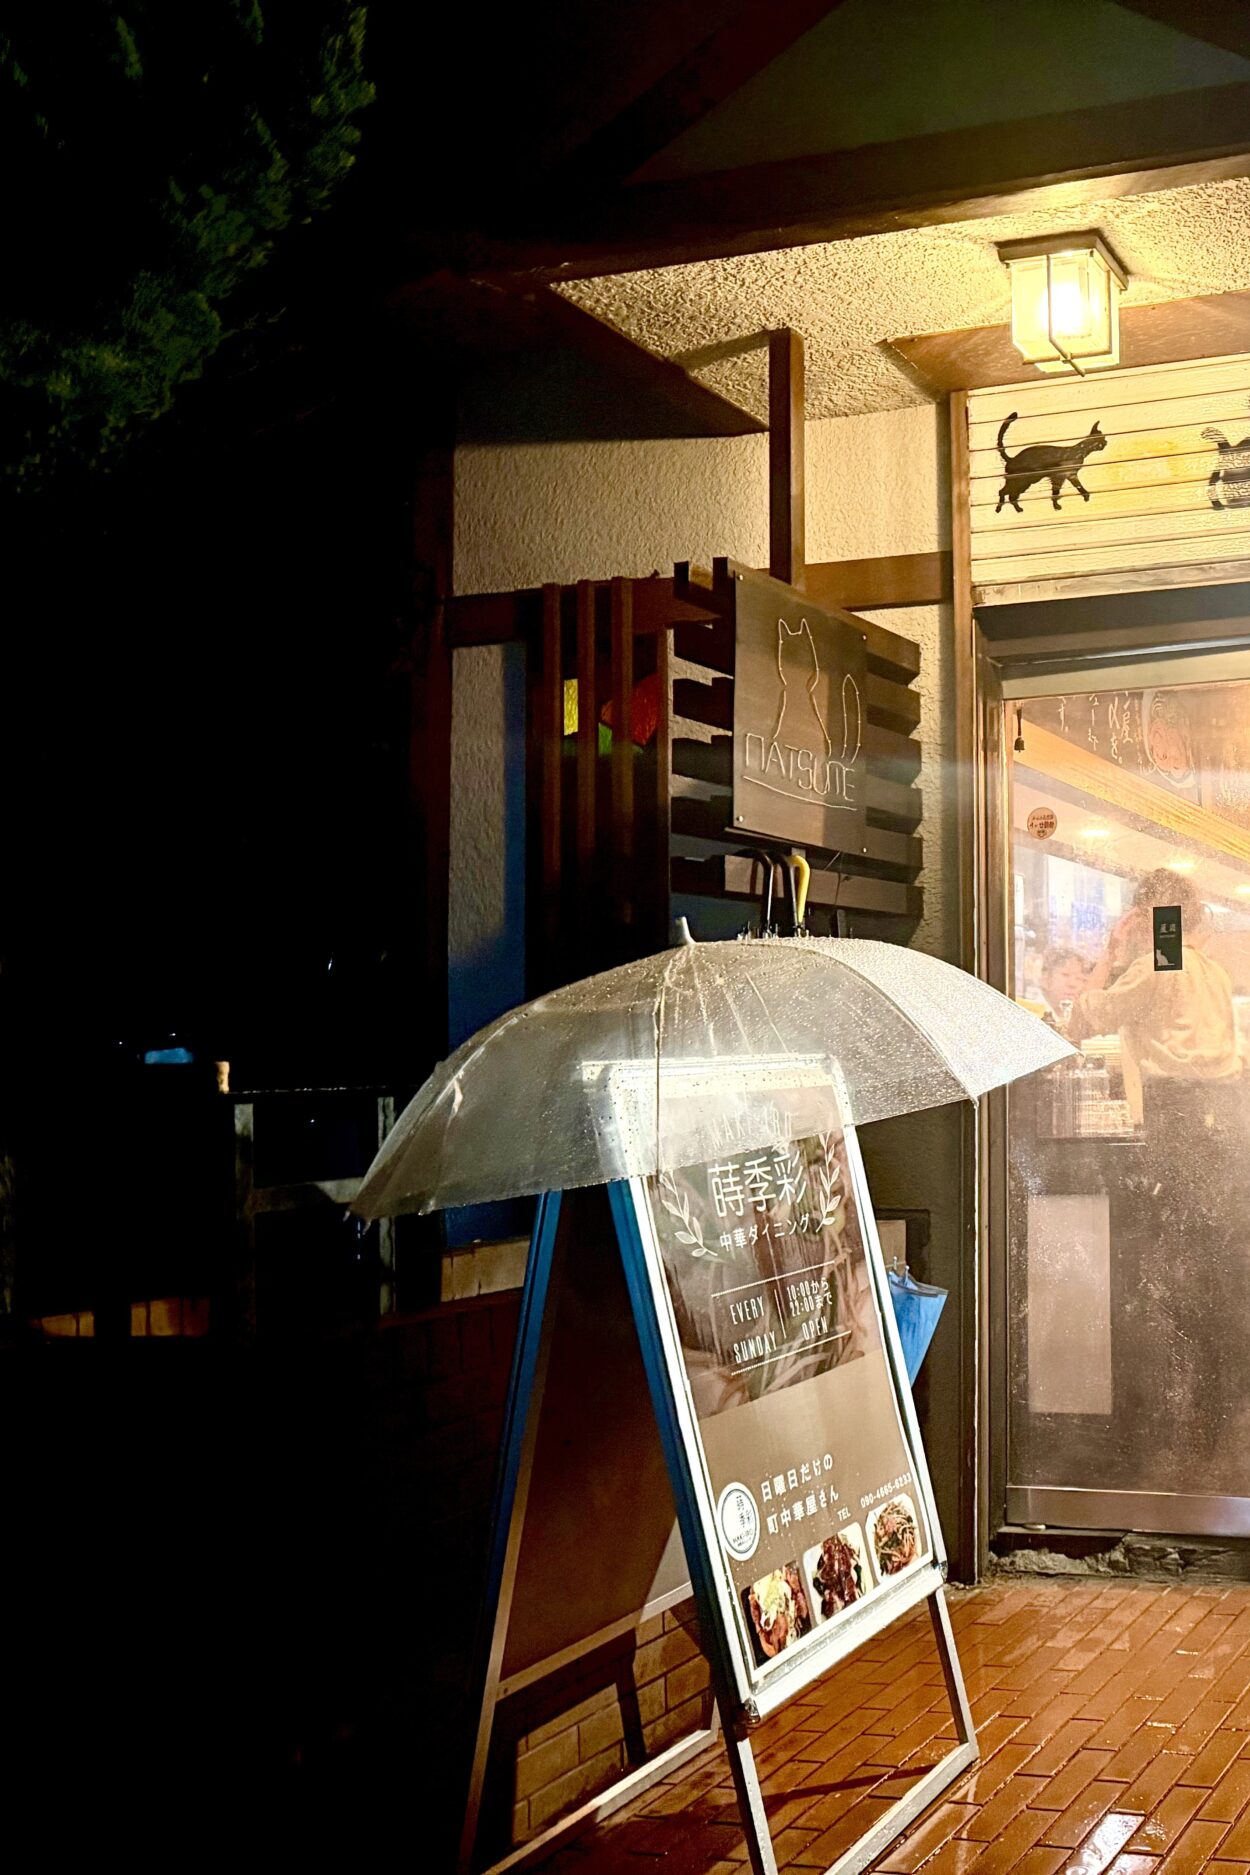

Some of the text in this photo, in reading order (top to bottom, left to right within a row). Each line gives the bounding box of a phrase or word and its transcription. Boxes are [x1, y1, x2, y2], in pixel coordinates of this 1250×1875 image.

[707, 1149, 807, 1218] 蒔季彩
[719, 1212, 810, 1252] 中華ダイニング
[729, 1295, 765, 1325] EVERY
[801, 1315, 829, 1341] OPEN
[733, 1330, 777, 1364] SUNDAY
[760, 1453, 833, 1503] 日曜日だけの
[765, 1484, 839, 1535] 町中華屋さん
[836, 1506, 852, 1522] TEL
